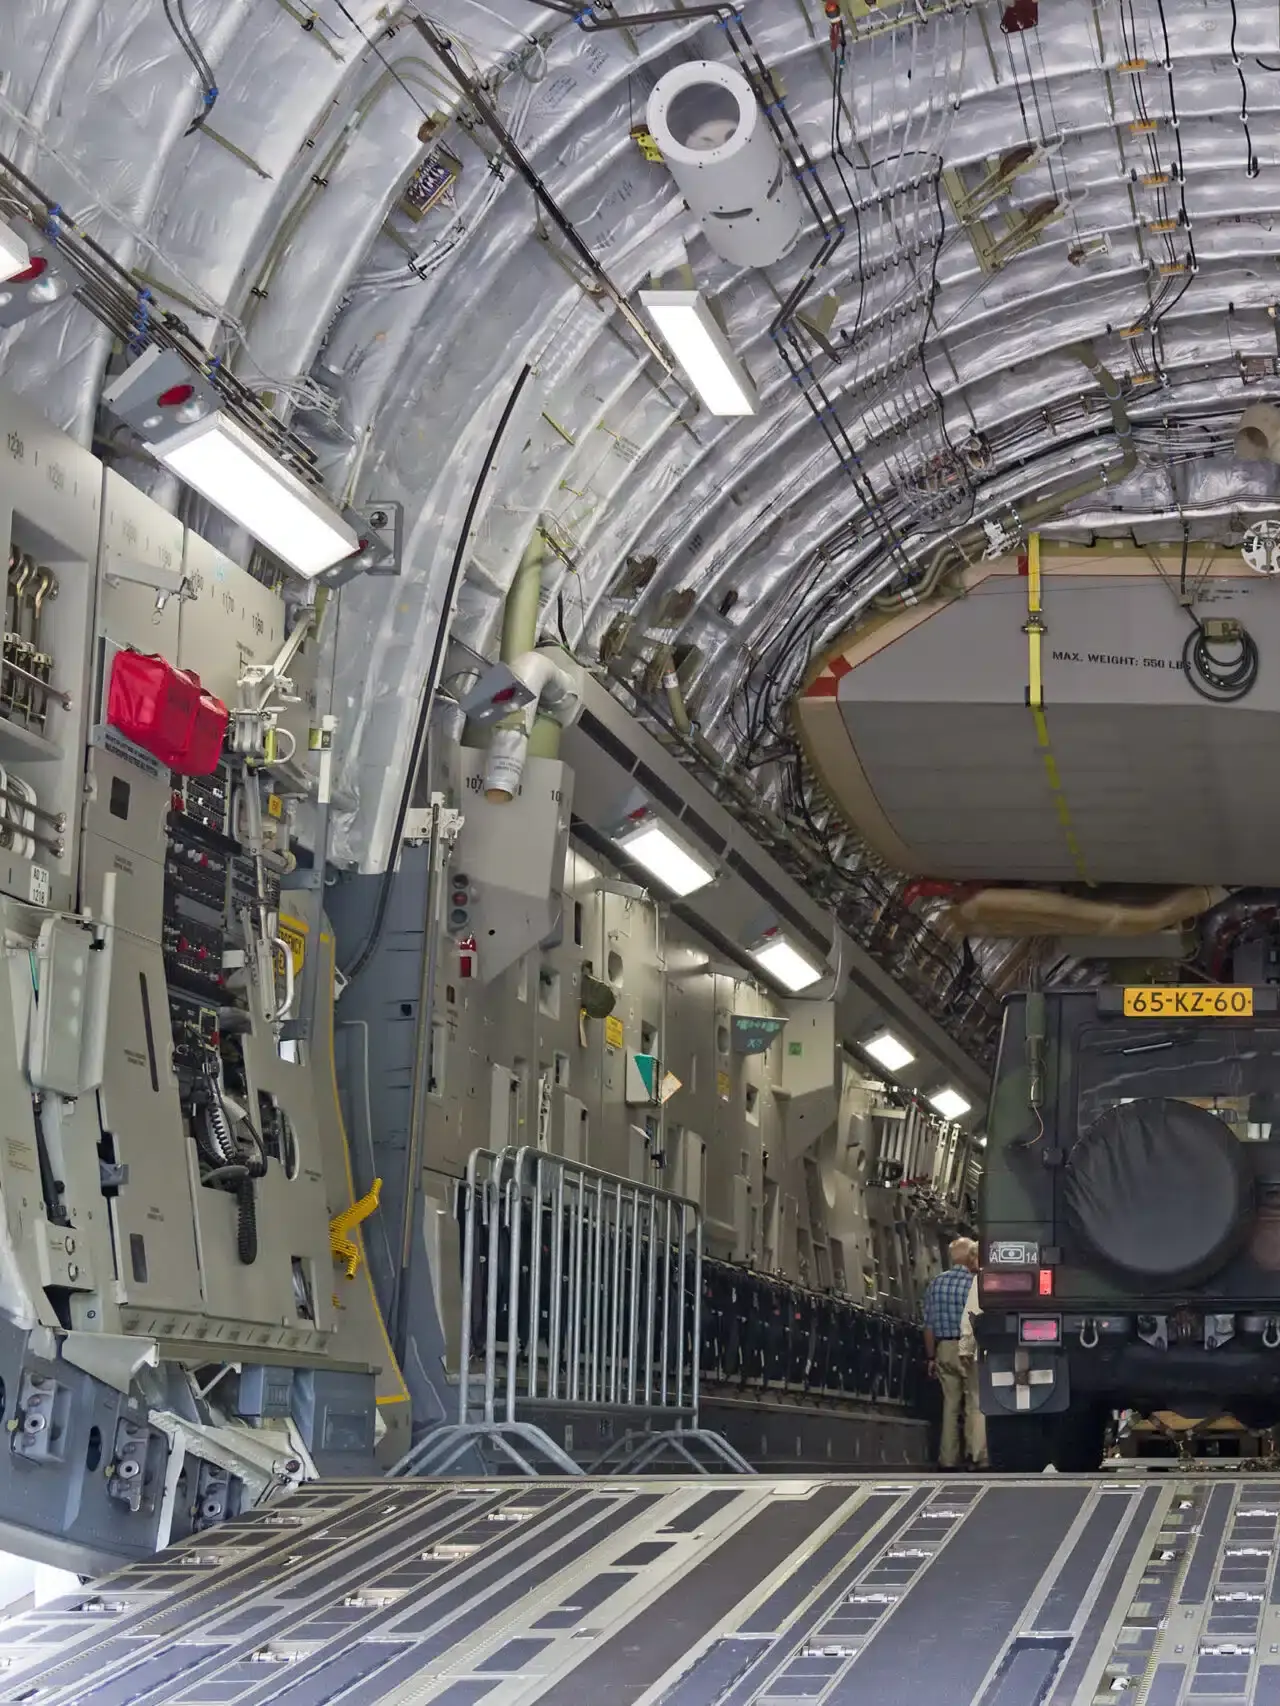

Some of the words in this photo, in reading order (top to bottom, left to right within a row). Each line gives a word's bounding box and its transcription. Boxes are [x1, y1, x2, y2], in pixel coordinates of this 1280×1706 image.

[1052, 651, 1084, 662] MAX.
[1088, 653, 1139, 667] WEIGHT:
[1143, 658, 1165, 669] 550
[1169, 660, 1192, 671] LBS
[466, 776, 485, 791] 107
[1133, 991, 1246, 1013] 65-KZ-60
[1025, 1251, 1038, 1263] 14
